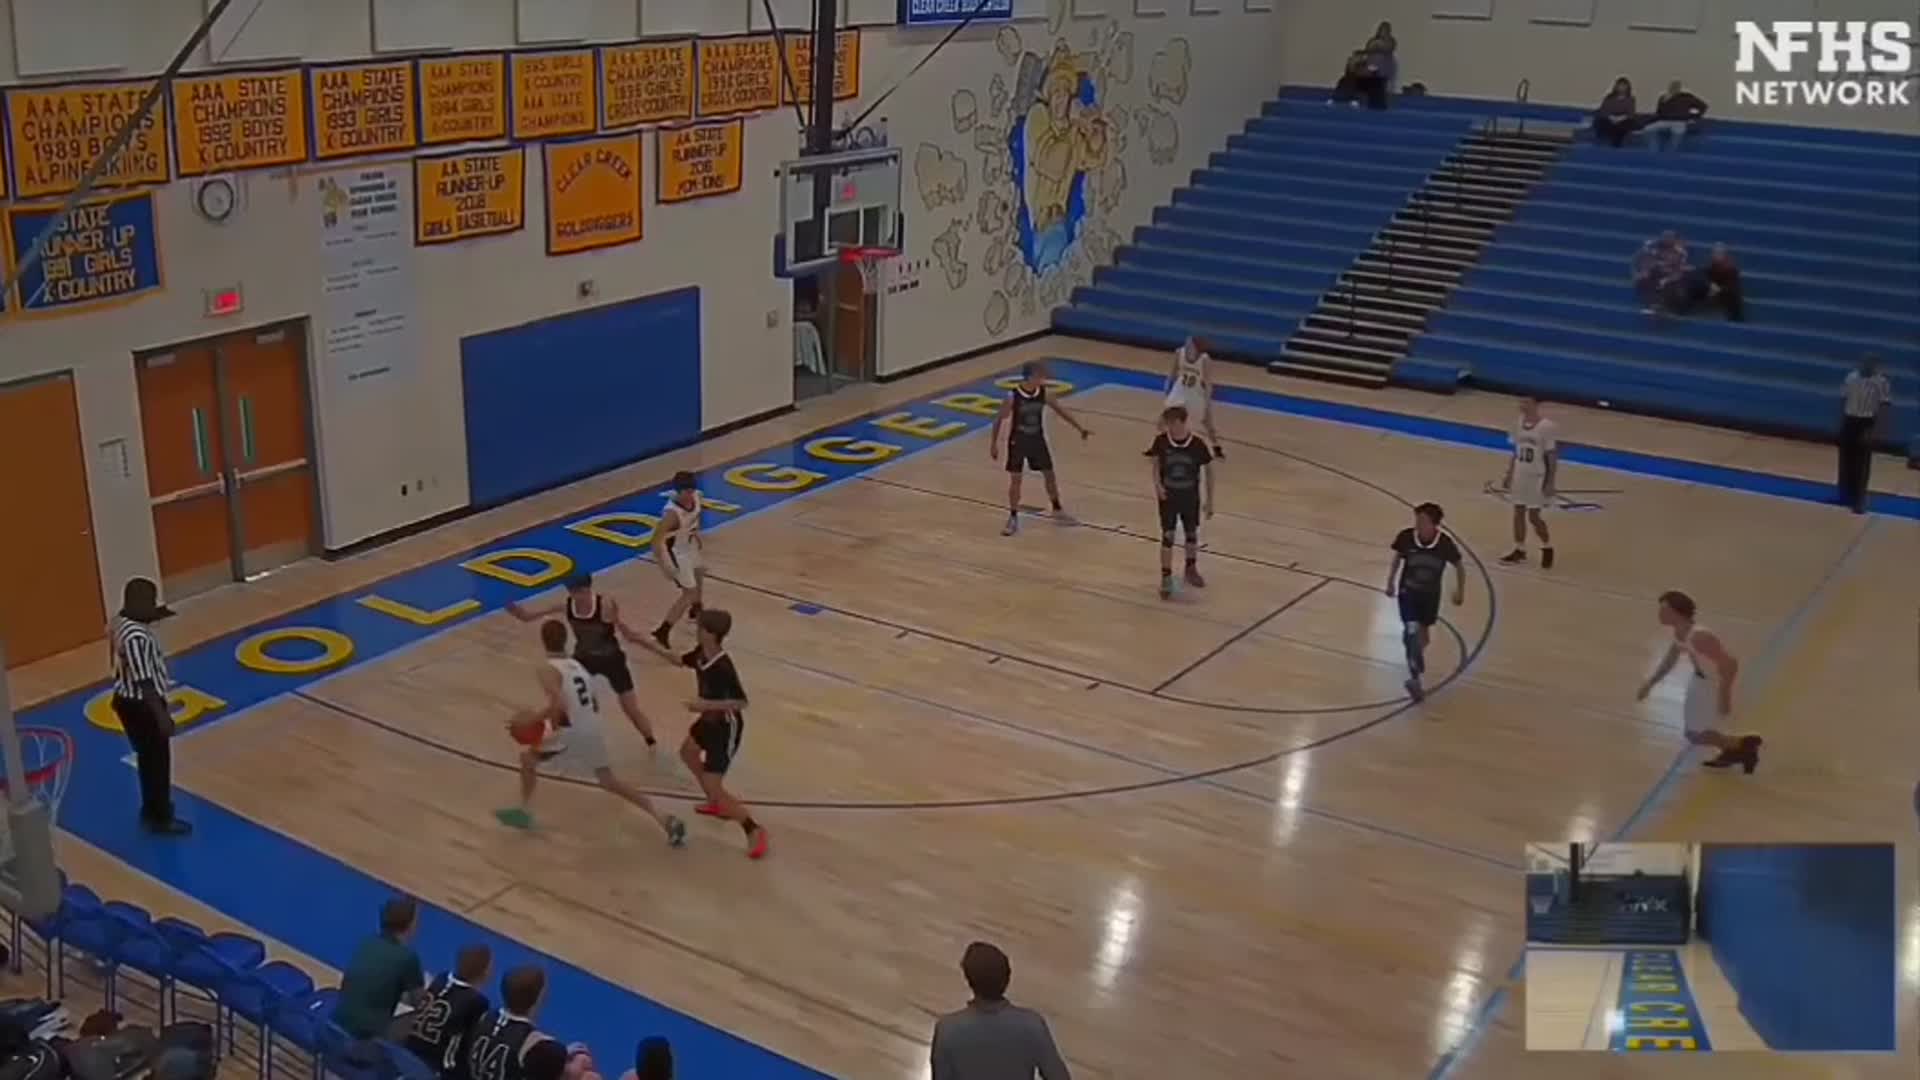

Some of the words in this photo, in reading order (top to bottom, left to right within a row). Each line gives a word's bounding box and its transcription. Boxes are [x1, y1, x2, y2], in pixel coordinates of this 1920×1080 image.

[644, 48, 682, 63] STATE
[735, 42, 771, 56] STATE
[459, 61, 492, 77] STATE
[608, 63, 685, 84] CHAMPIONS
[702, 56, 773, 74] CHAMPIONS
[319, 72, 349, 89] AAA
[362, 68, 405, 87] STATE
[191, 84, 224, 102] AAA
[239, 77, 287, 98] STATE
[322, 86, 404, 111] CHAMPIONS
[551, 92, 584, 108] STATE
[26, 98, 69, 118] AAA
[193, 97, 287, 124] CHAMPIONS
[242, 118, 283, 138] BOYS
[340, 124, 404, 147] COUNTRY
[33, 139, 81, 162] 1989
[214, 139, 288, 163] COUNTRY
[441, 162, 459, 178] AA
[464, 156, 501, 173] STATE
[556, 151, 592, 193] CLEAR
[596, 147, 633, 180] CREEK
[57, 270, 137, 300] COUNTRY
